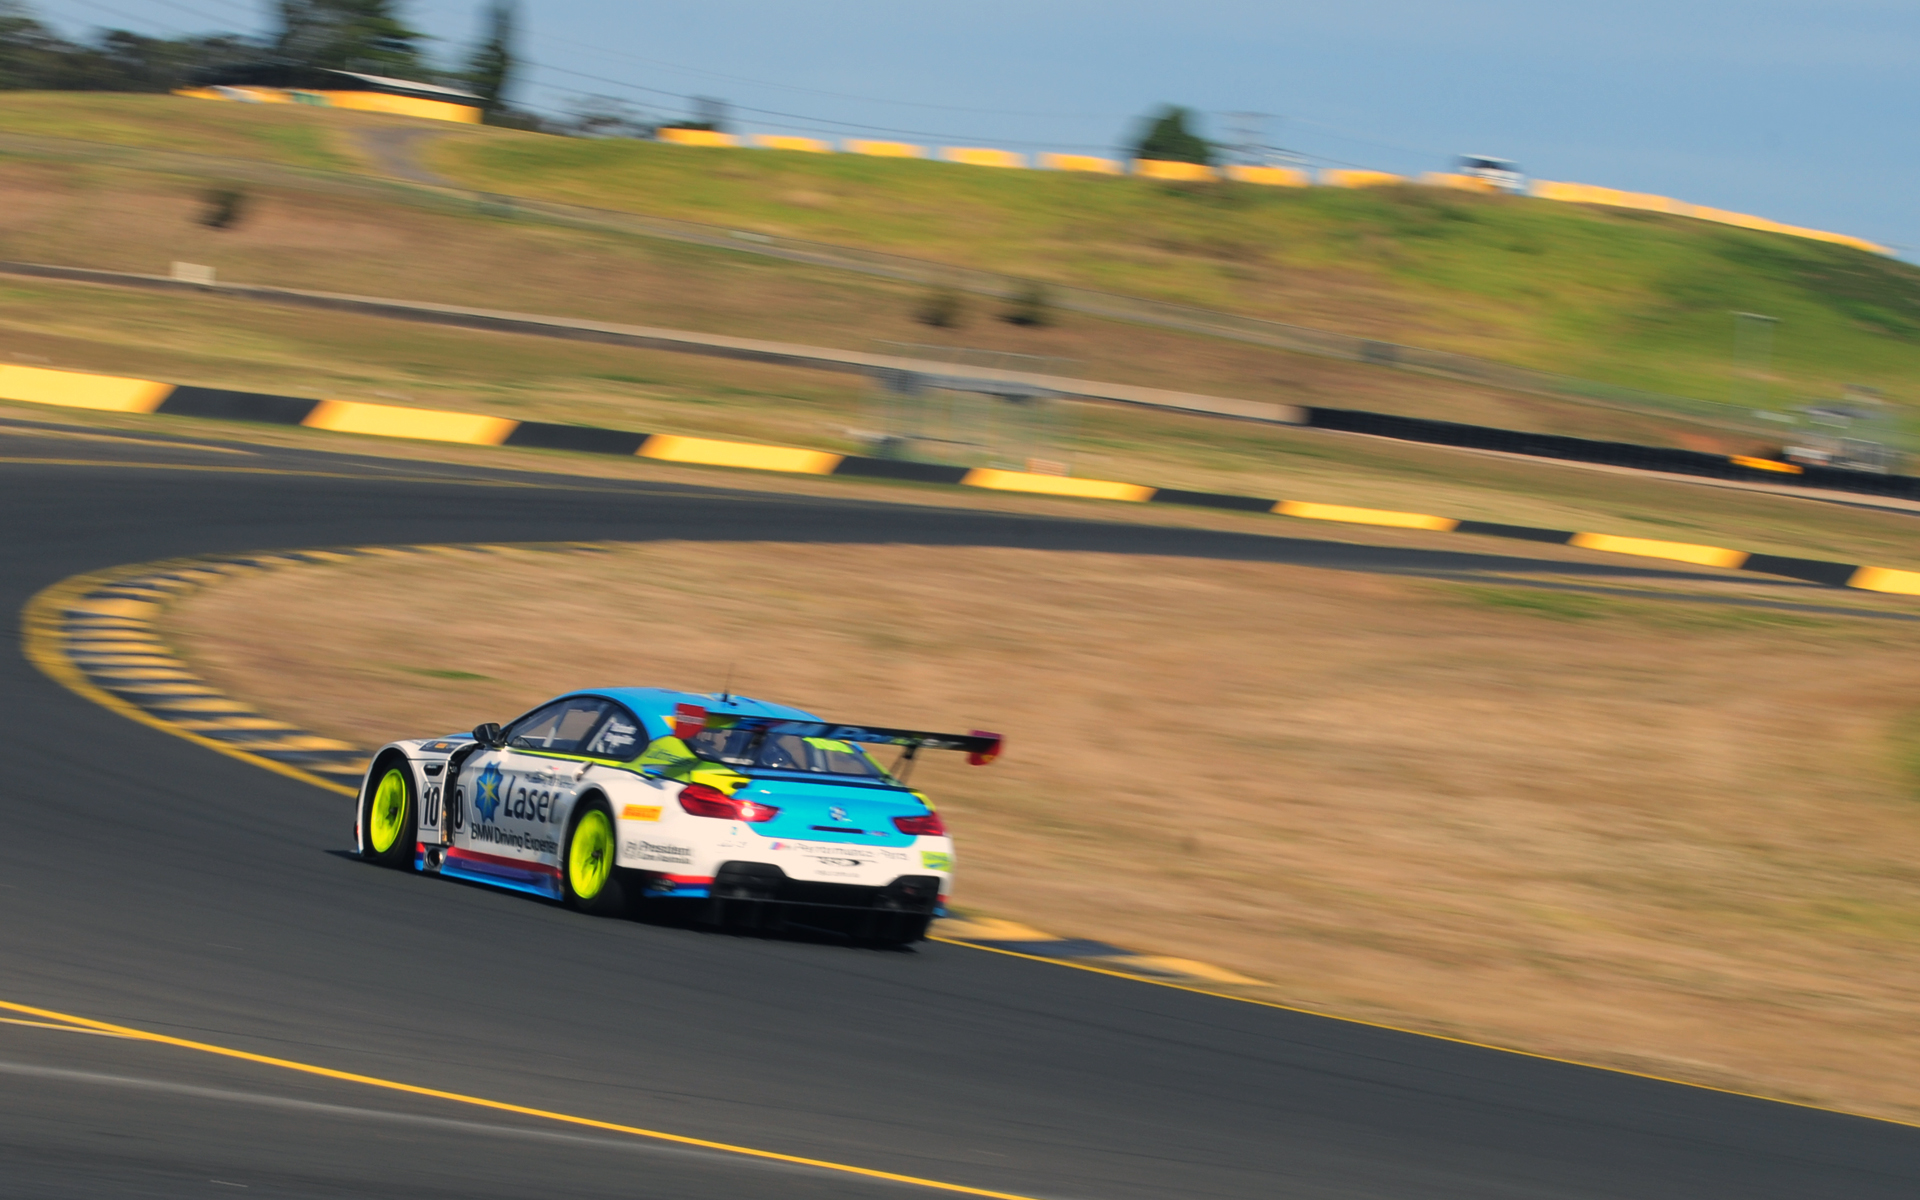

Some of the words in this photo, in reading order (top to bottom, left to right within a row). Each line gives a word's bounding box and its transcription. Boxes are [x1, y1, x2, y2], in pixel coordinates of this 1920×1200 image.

[504, 774, 561, 824] Laser
[471, 822, 494, 843] BMW
[494, 826, 524, 853] Driving
